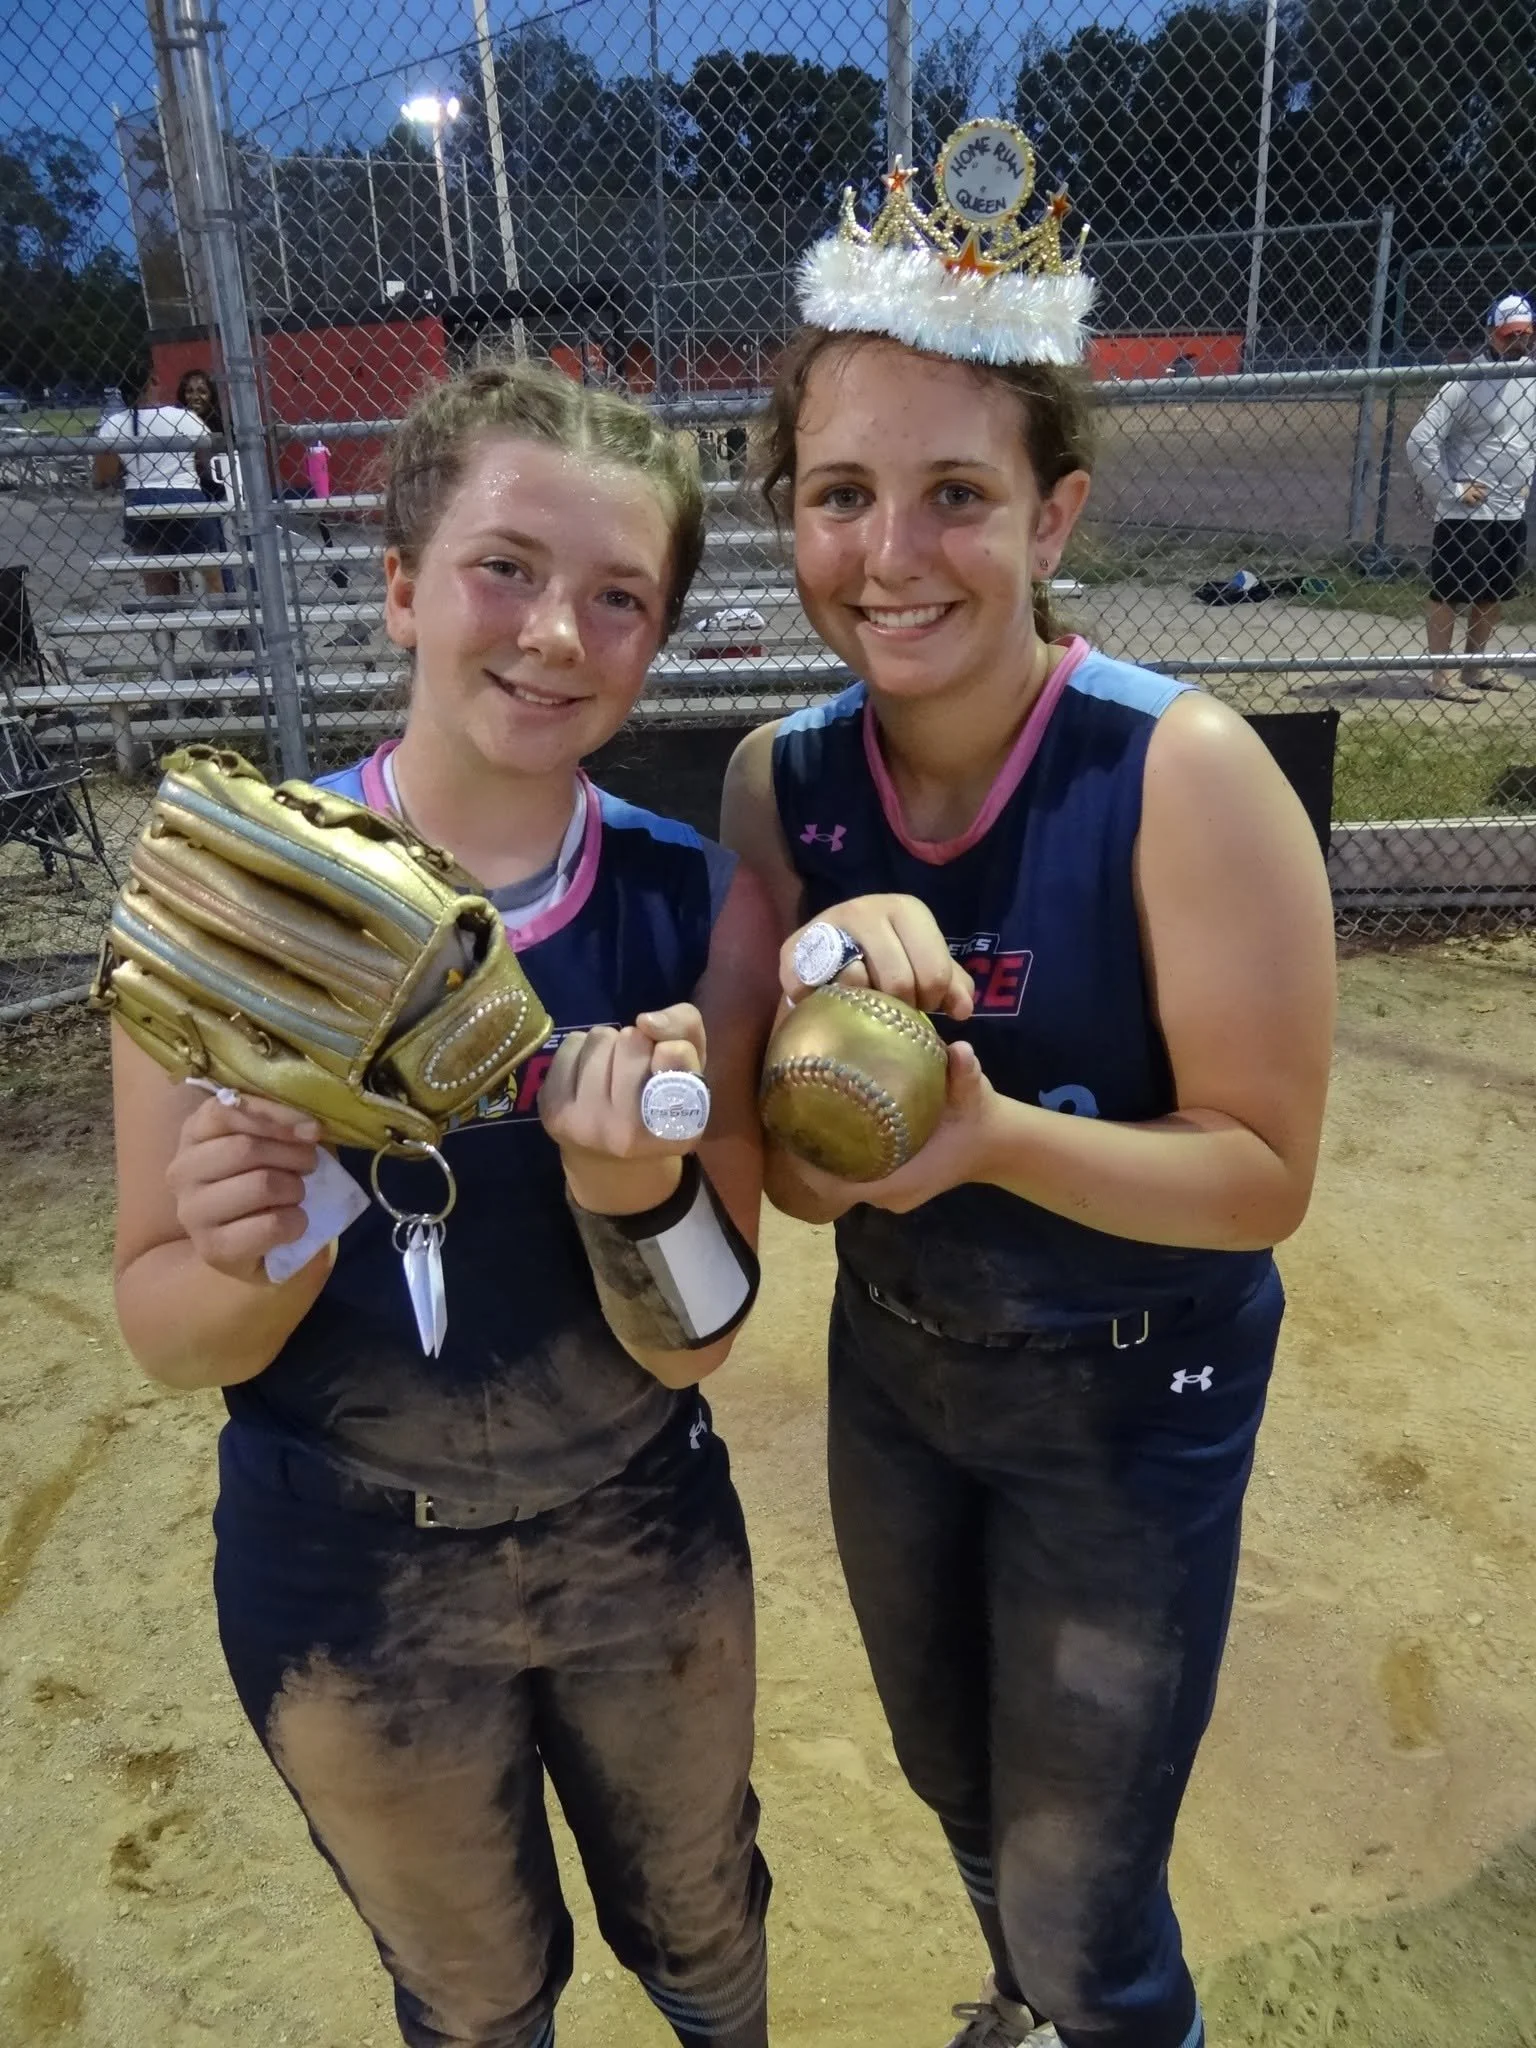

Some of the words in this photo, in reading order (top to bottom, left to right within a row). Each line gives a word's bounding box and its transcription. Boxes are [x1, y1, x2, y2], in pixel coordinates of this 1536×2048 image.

[950, 136, 991, 178] HOME
[992, 141, 1025, 180] RUN
[956, 188, 1007, 213] QUEEN
